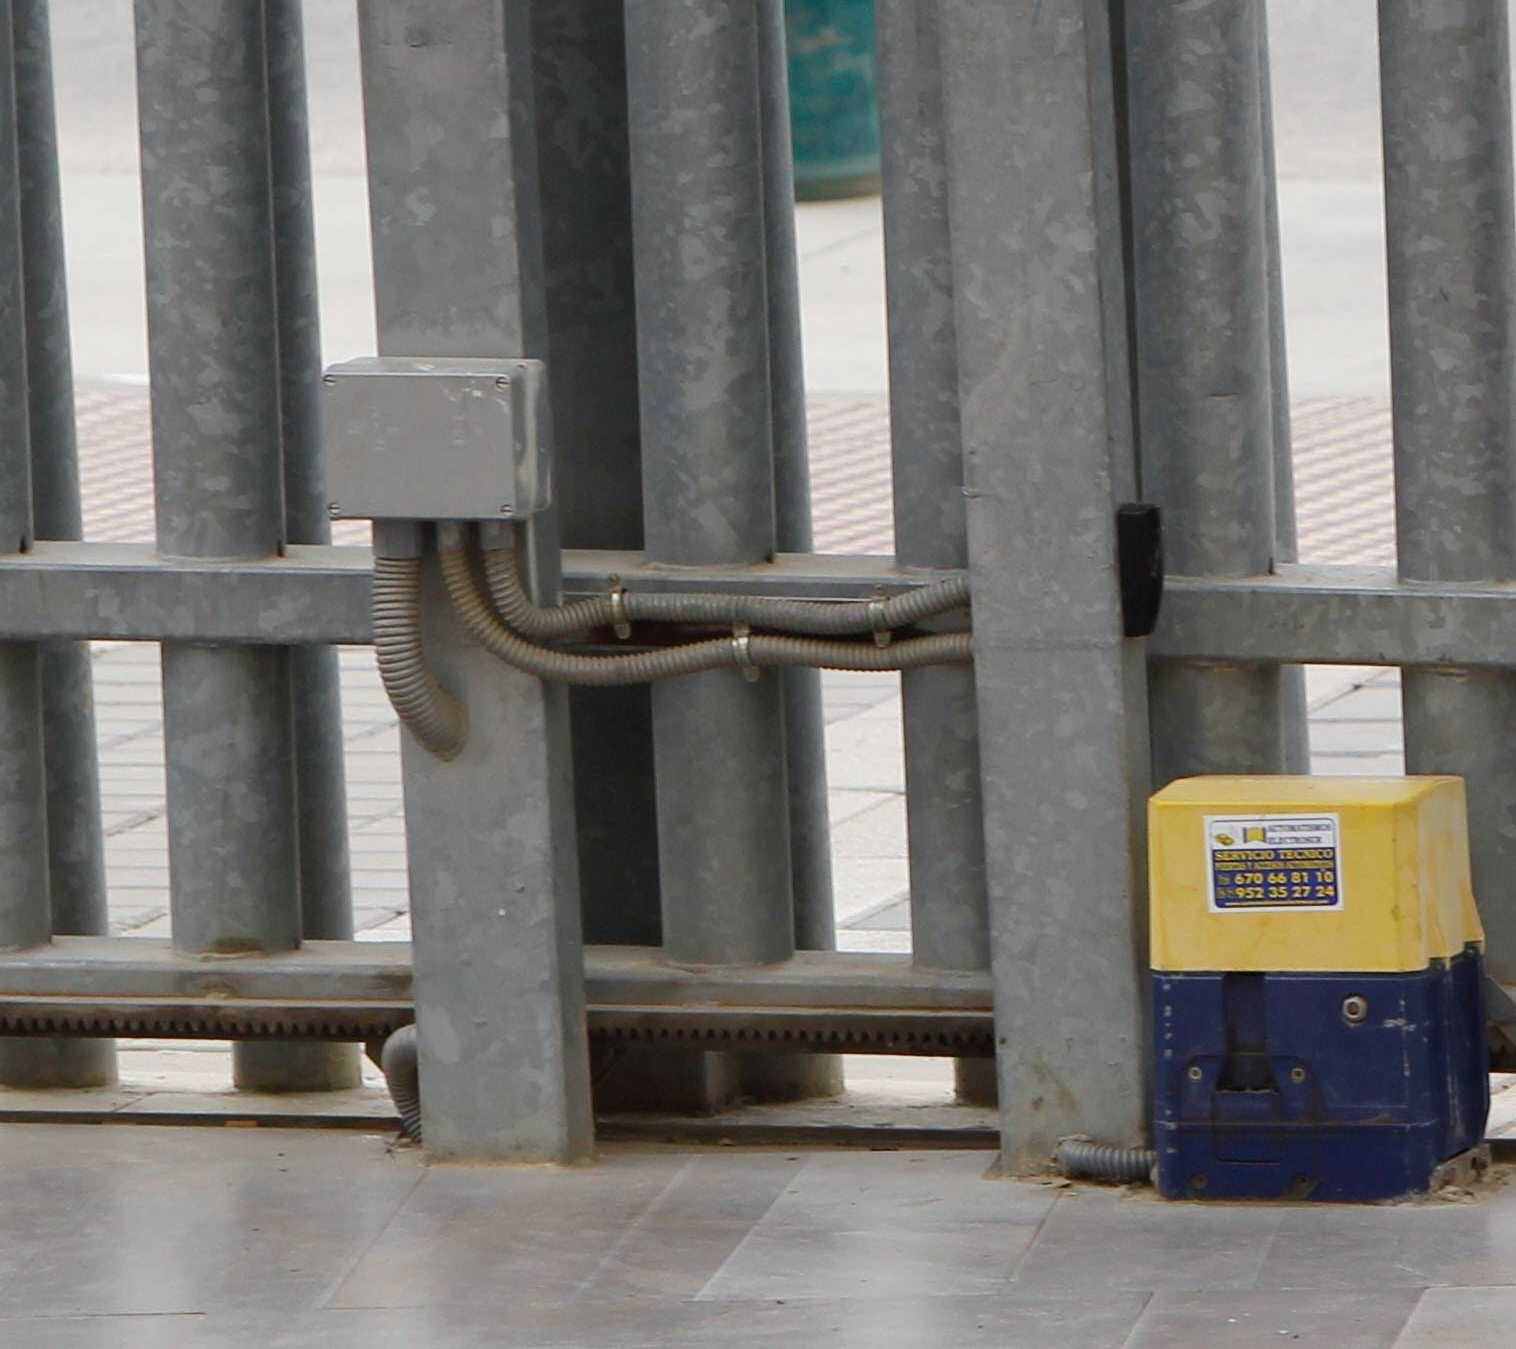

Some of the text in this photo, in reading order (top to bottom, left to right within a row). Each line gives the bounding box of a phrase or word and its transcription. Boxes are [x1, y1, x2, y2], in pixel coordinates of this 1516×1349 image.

[1214, 849, 1333, 861] SERVICIO TECNICO
[1234, 872, 1264, 885] 670
[1267, 872, 1287, 884] 66
[1291, 871, 1309, 883] 81
[1315, 871, 1334, 883] 10
[1235, 887, 1265, 899] 952
[1268, 886, 1288, 898] 35
[1291, 886, 1312, 898] 27
[1315, 885, 1335, 898] 24
